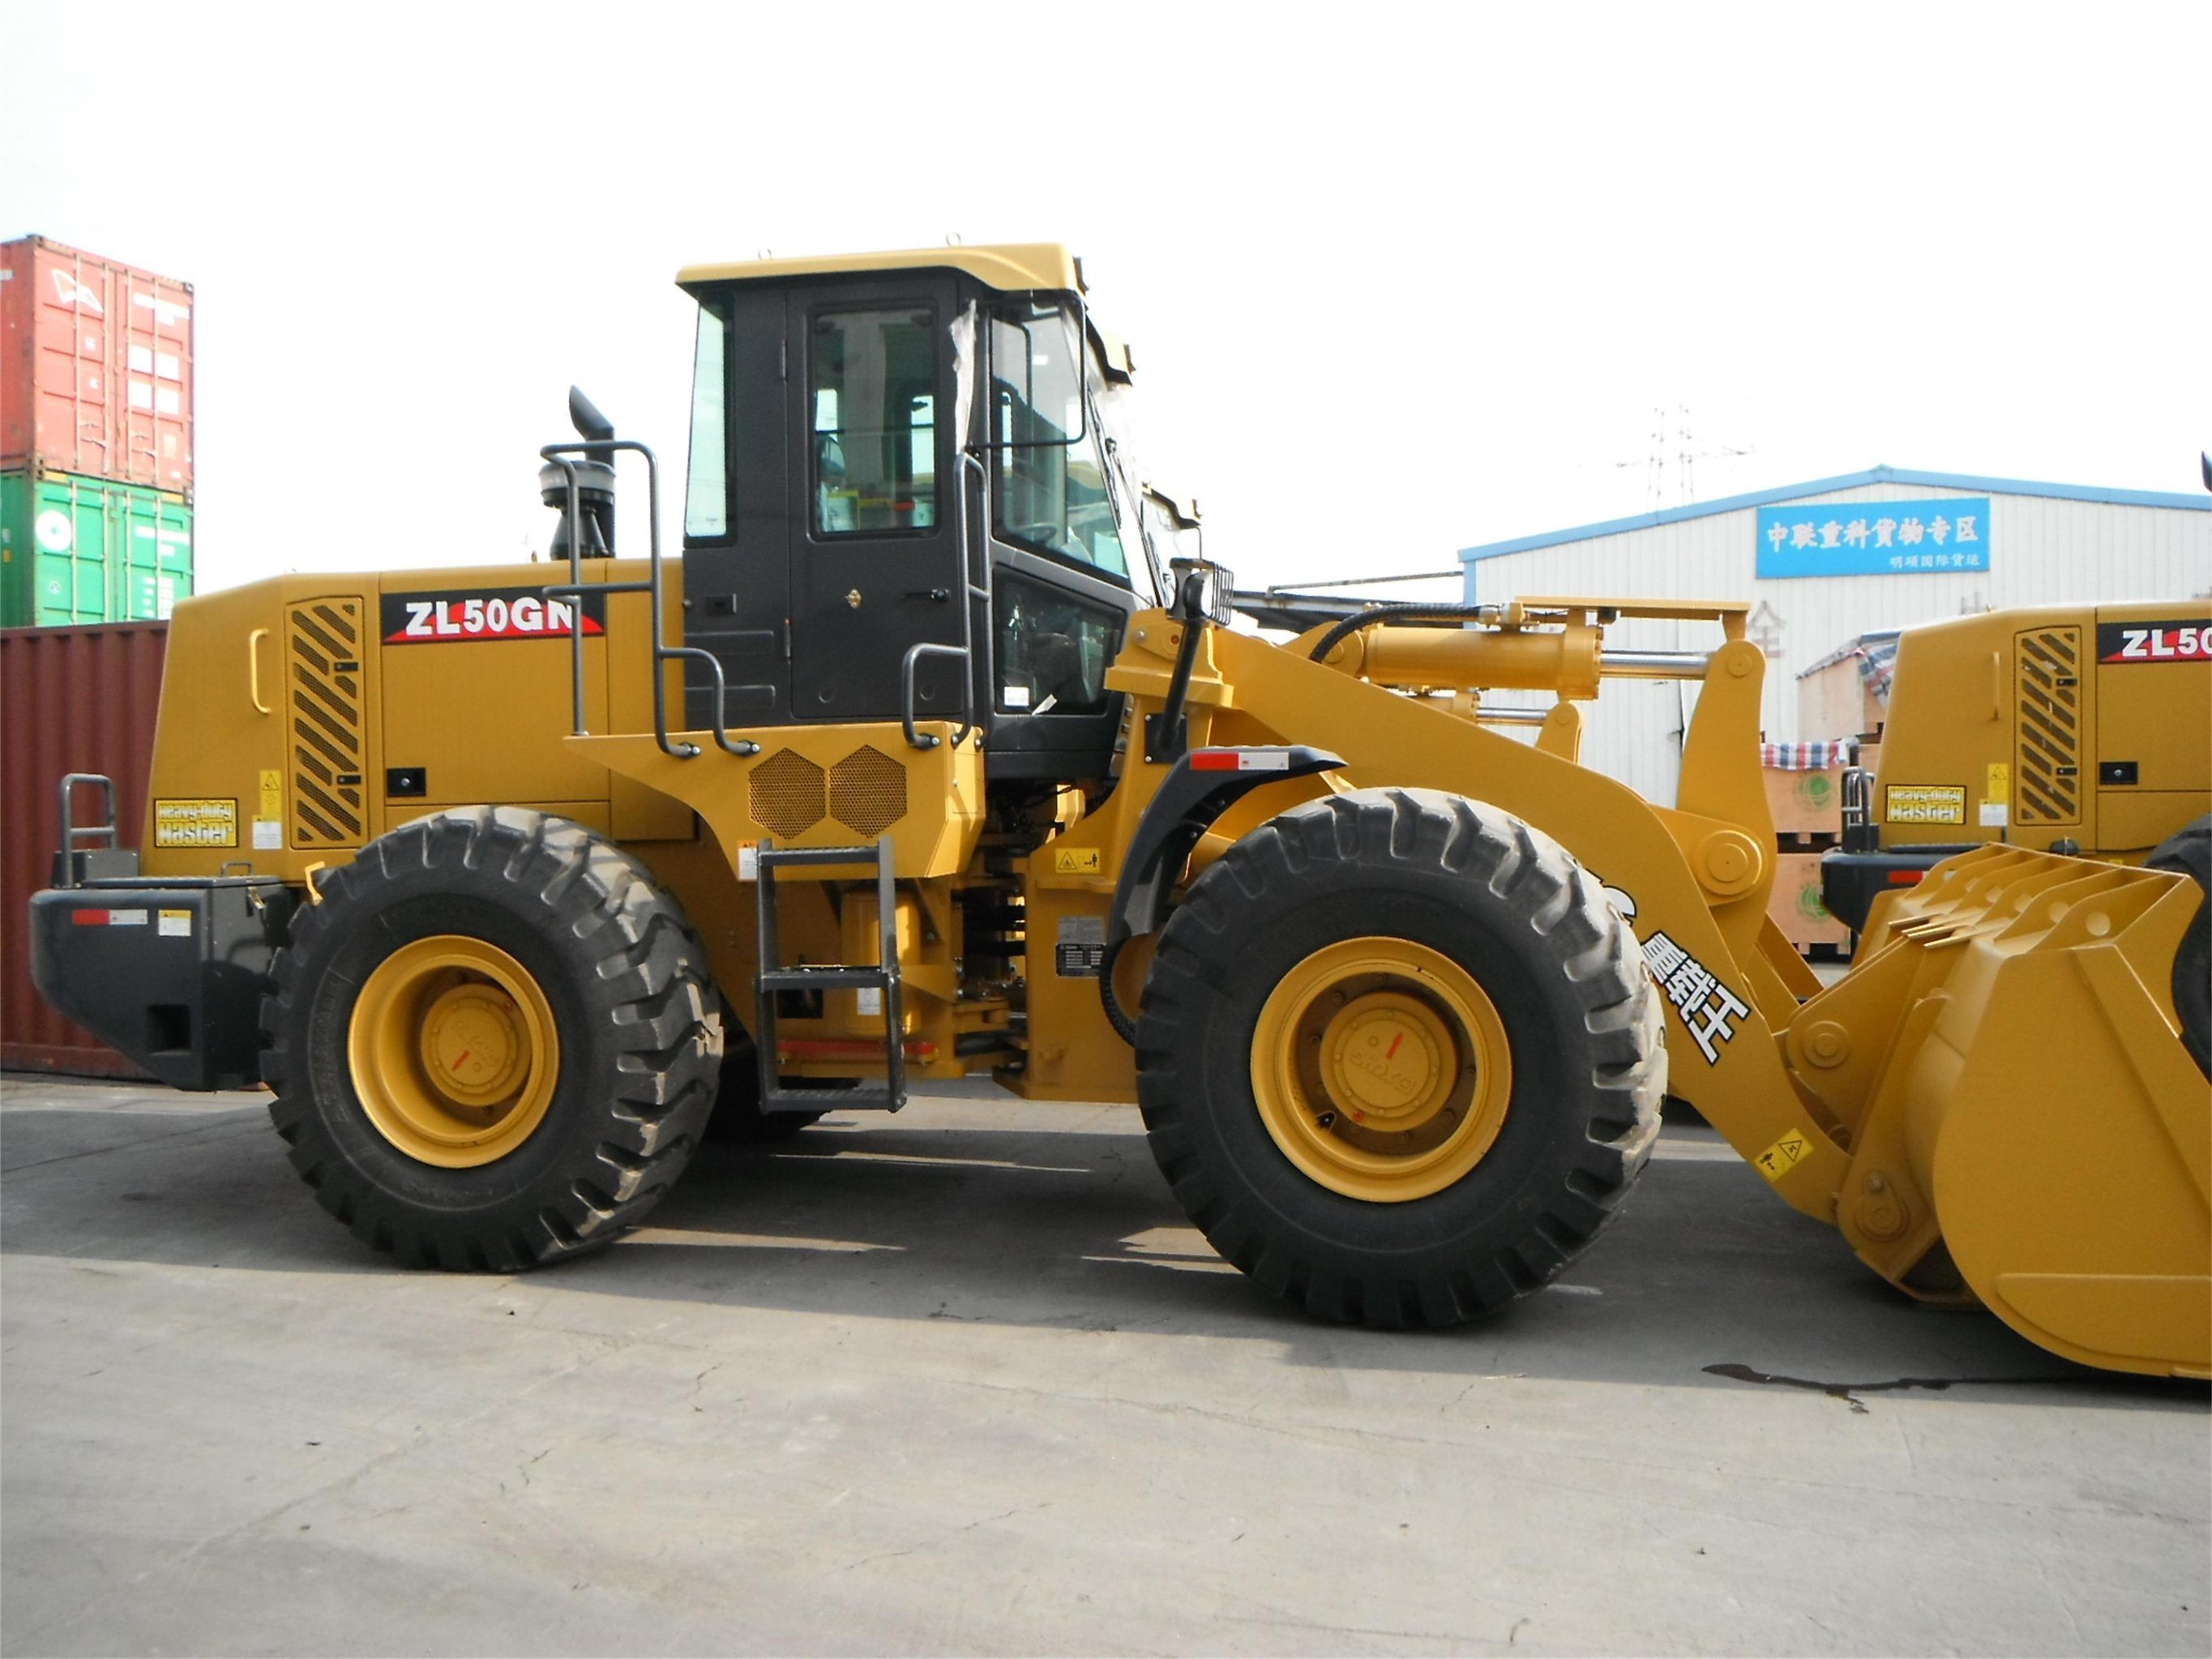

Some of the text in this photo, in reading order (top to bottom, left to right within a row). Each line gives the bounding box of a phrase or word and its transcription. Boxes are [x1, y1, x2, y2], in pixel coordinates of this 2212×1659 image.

[405, 596, 573, 635] ZL50GN
[1890, 803, 1962, 822] Master
[159, 821, 234, 844] Master
